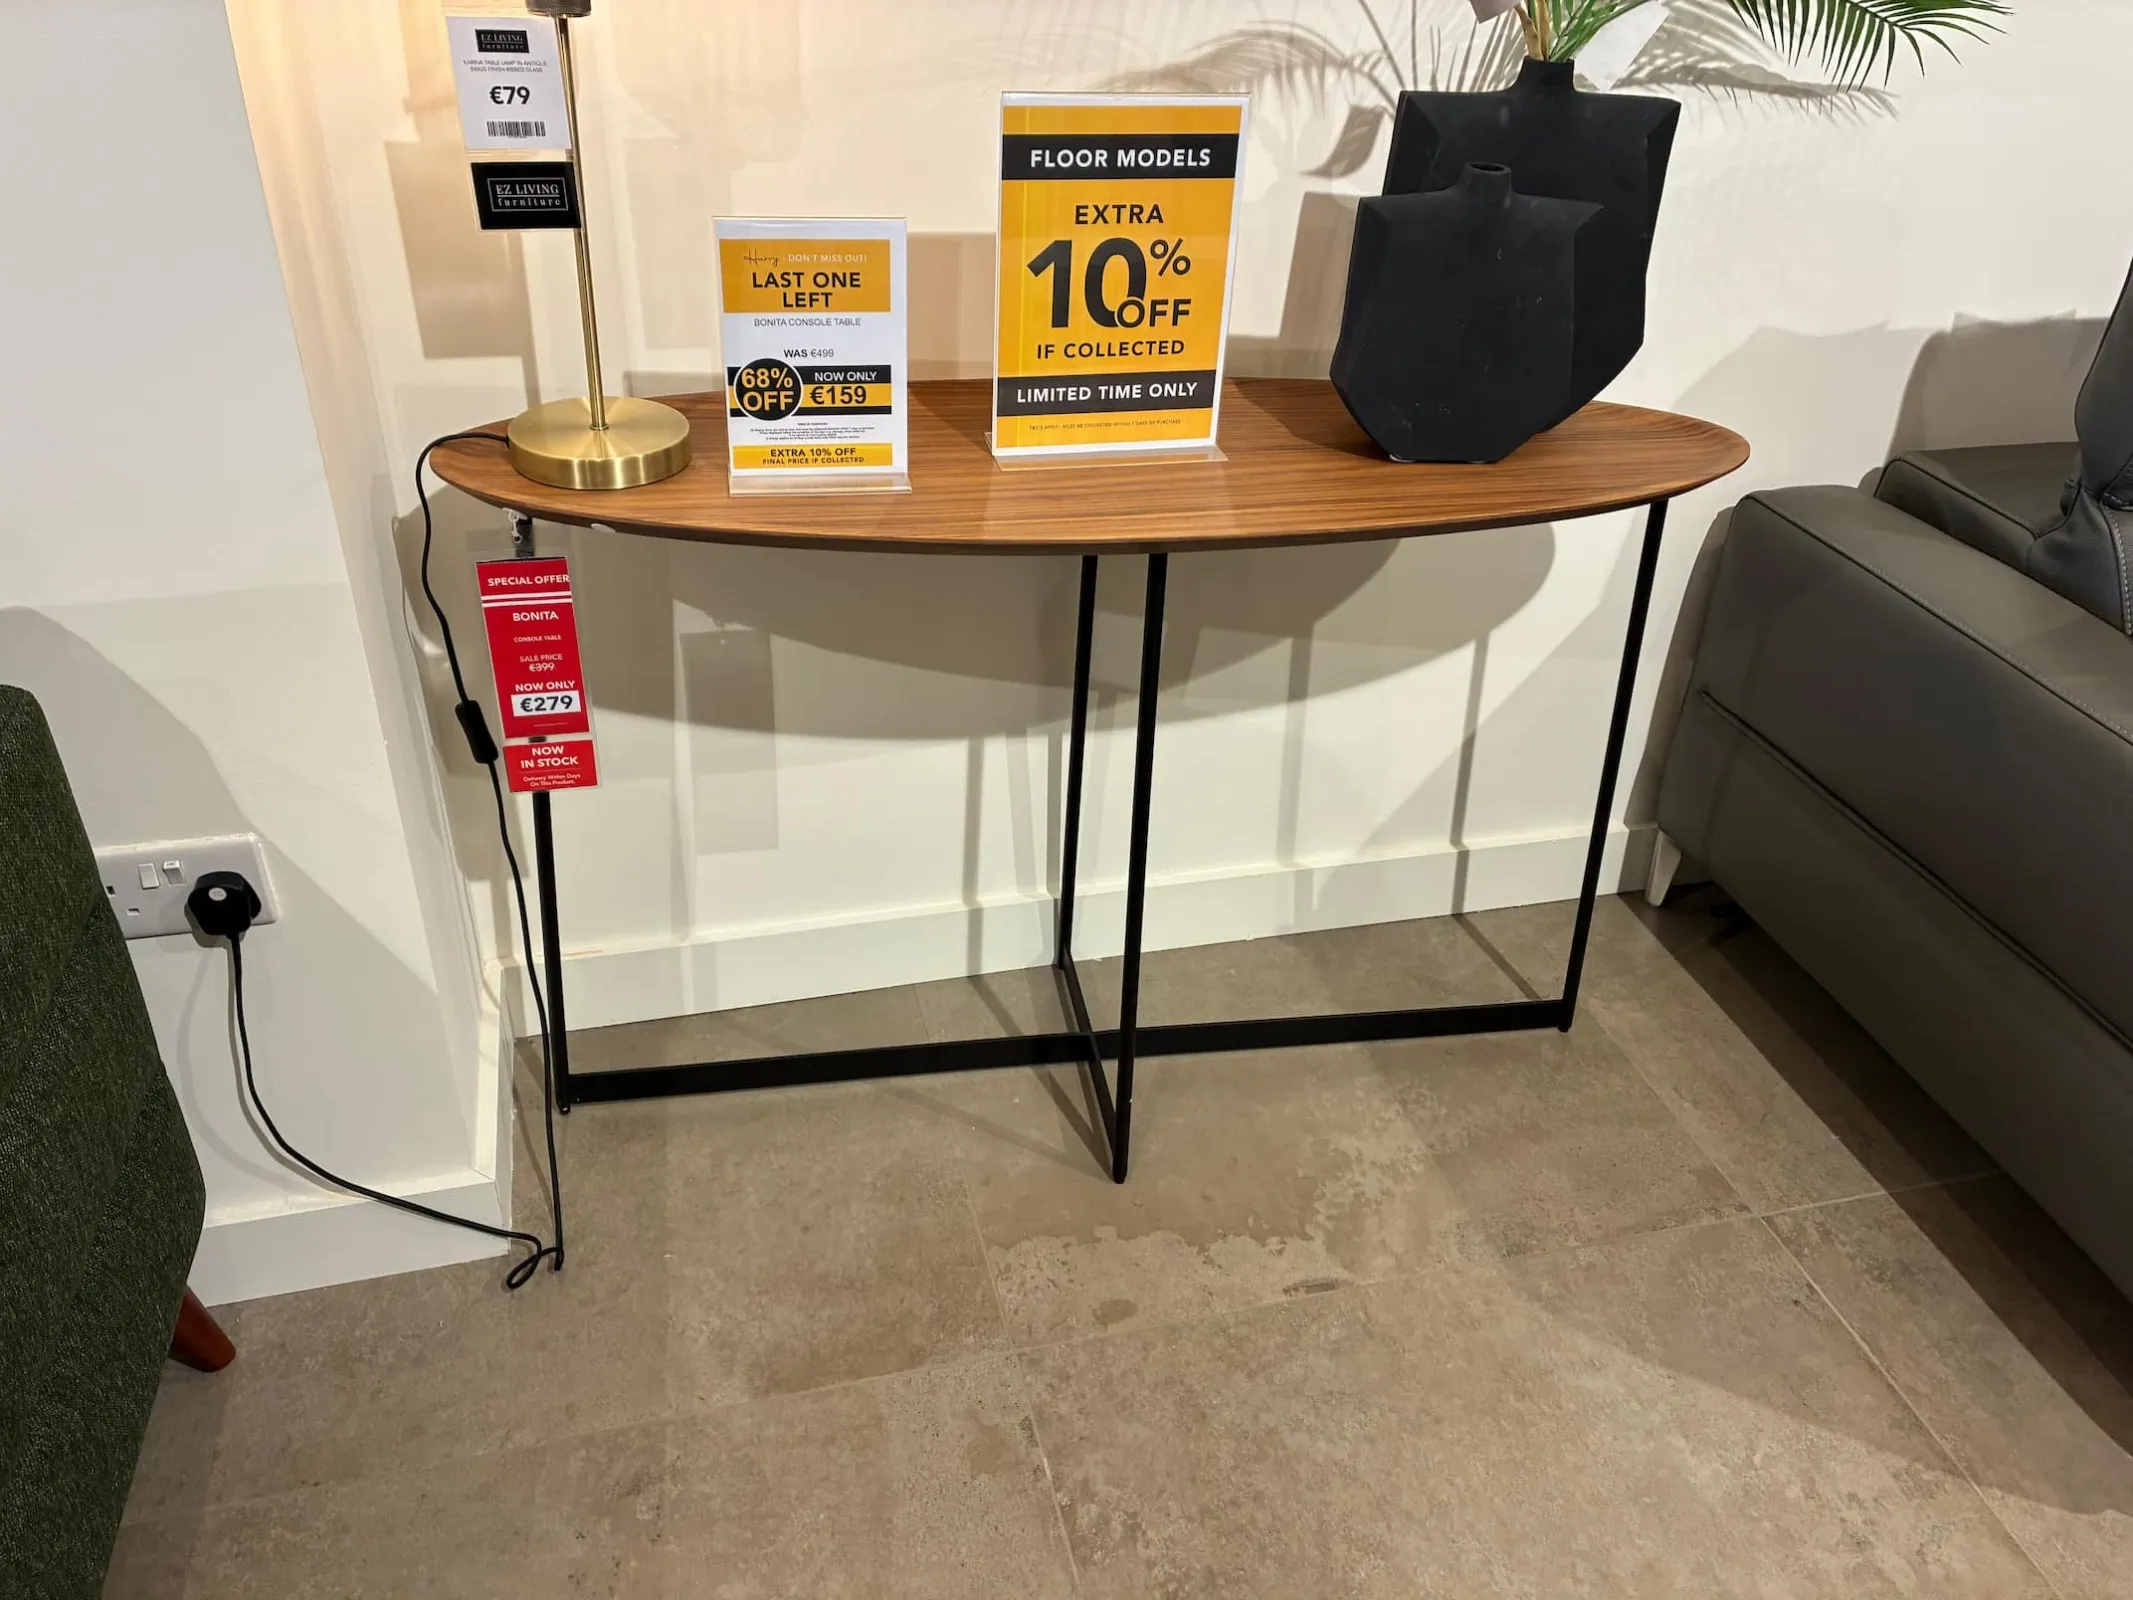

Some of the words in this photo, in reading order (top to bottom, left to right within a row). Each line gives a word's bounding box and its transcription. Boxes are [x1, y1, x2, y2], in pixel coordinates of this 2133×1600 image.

[489, 86, 530, 105] €79
[1030, 149, 1108, 168] FLOOR
[1117, 148, 1211, 167] MODELS
[496, 184, 512, 194] EZ
[516, 184, 559, 194] LIVING
[498, 198, 561, 206] furniture
[1075, 204, 1164, 225] EXTRA
[788, 254, 818, 262] DON'T
[820, 254, 841, 262] MISS
[844, 254, 867, 262] OUT!
[752, 272, 805, 288] LAST
[813, 272, 861, 288] ONE
[783, 292, 833, 308] LEFT
[1117, 298, 1192, 328] OFF
[754, 318, 786, 326] BONITA
[788, 318, 832, 326] CONSOLE
[834, 317, 861, 326] TABLE
[783, 350, 808, 358] WAS
[810, 349, 834, 358] €499
[1037, 344, 1056, 359] IF
[1064, 340, 1185, 358] COLLECTED
[741, 368, 794, 389] 68%
[814, 372, 845, 382] NOW
[846, 371, 878, 382] ONLY
[810, 386, 867, 405] €159
[1017, 386, 1092, 404] LIMITED
[1098, 384, 1142, 400] TIME
[1149, 382, 1198, 398] ONLY
[742, 391, 794, 412] OFF
[770, 449, 806, 457] EXTRA
[810, 448, 831, 457] 10%
[835, 448, 856, 456] OFF
[487, 576, 532, 587] SPECIAL
[534, 574, 570, 585] OFFER
[512, 610, 559, 622] BONITA
[528, 662, 555, 672] €399
[515, 682, 544, 692] NOW
[546, 680, 575, 690] ONLY
[520, 695, 573, 712] €279
[532, 746, 564, 756] NOW
[520, 760, 534, 769] IN
[537, 756, 579, 768] STOCK
